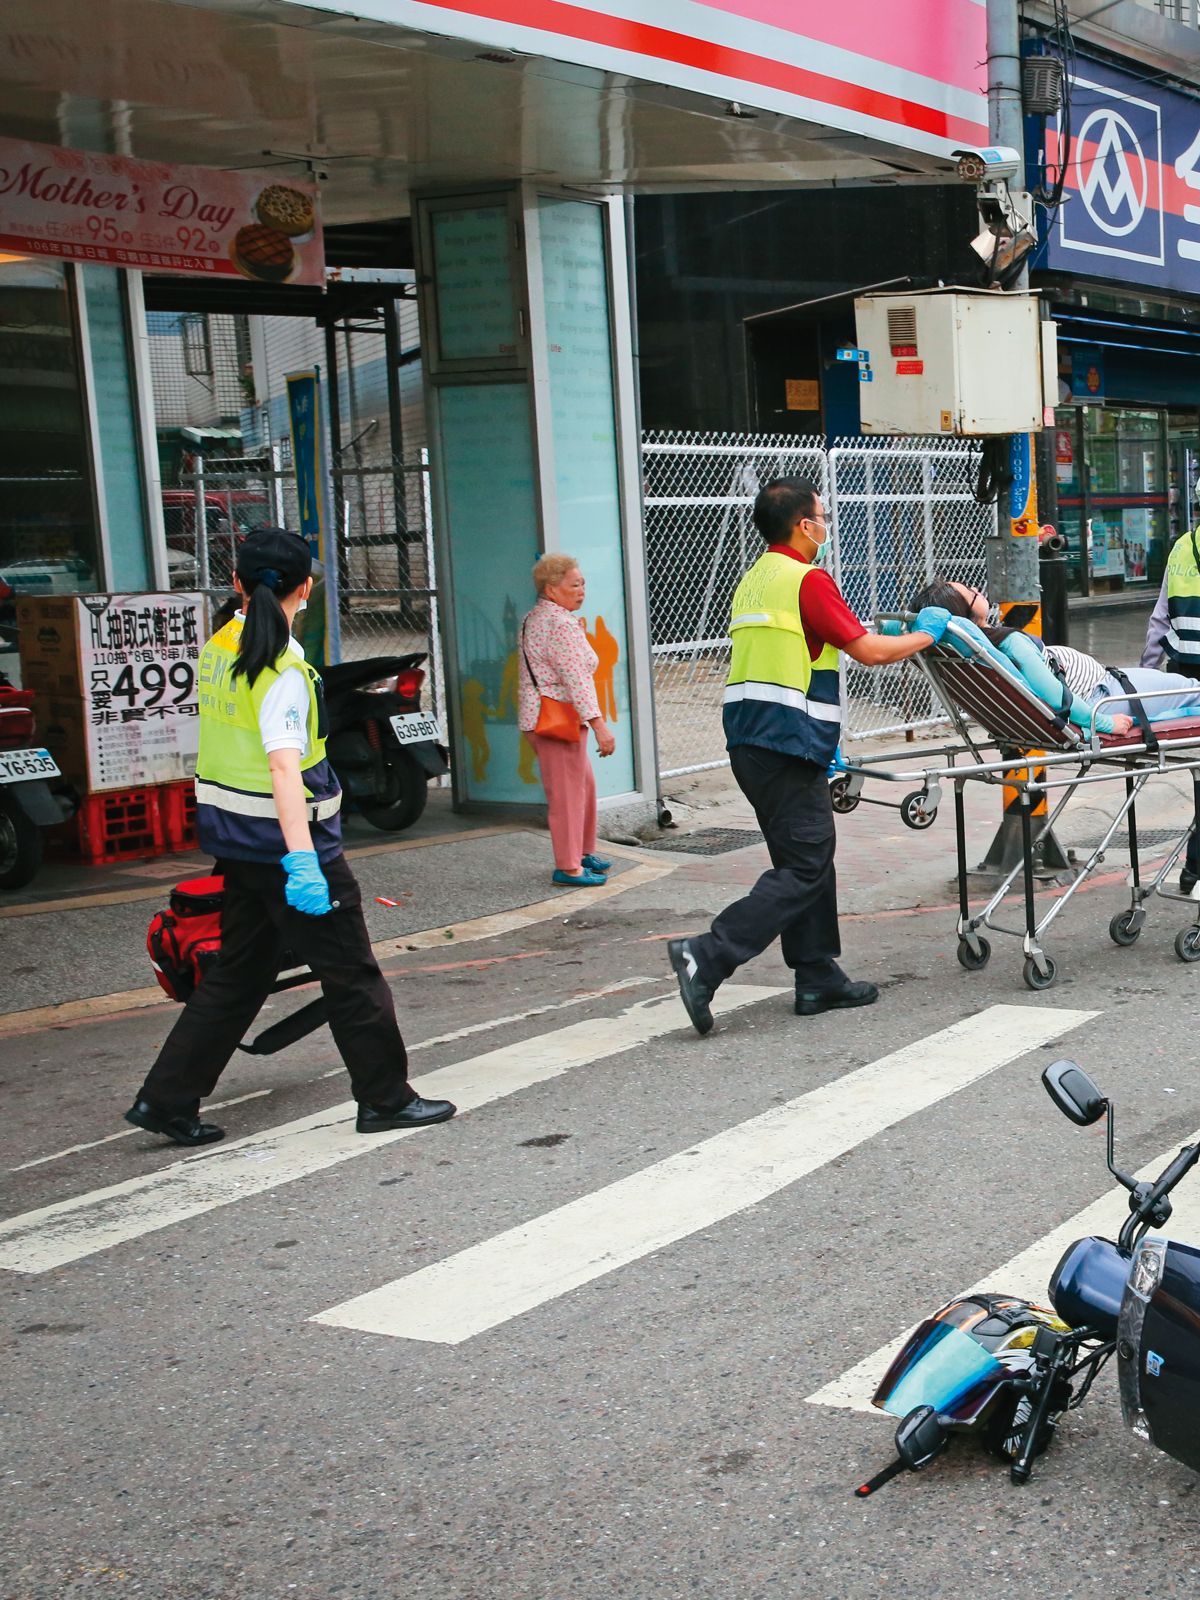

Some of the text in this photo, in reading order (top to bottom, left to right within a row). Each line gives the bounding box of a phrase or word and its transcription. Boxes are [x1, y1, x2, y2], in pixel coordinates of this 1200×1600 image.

[0, 163, 235, 232] Mother's Day
[91, 670, 112, 710] 只要
[112, 661, 194, 707] 499
[91, 703, 199, 726] 非買不可
[396, 720, 438, 739] 639-BBT
